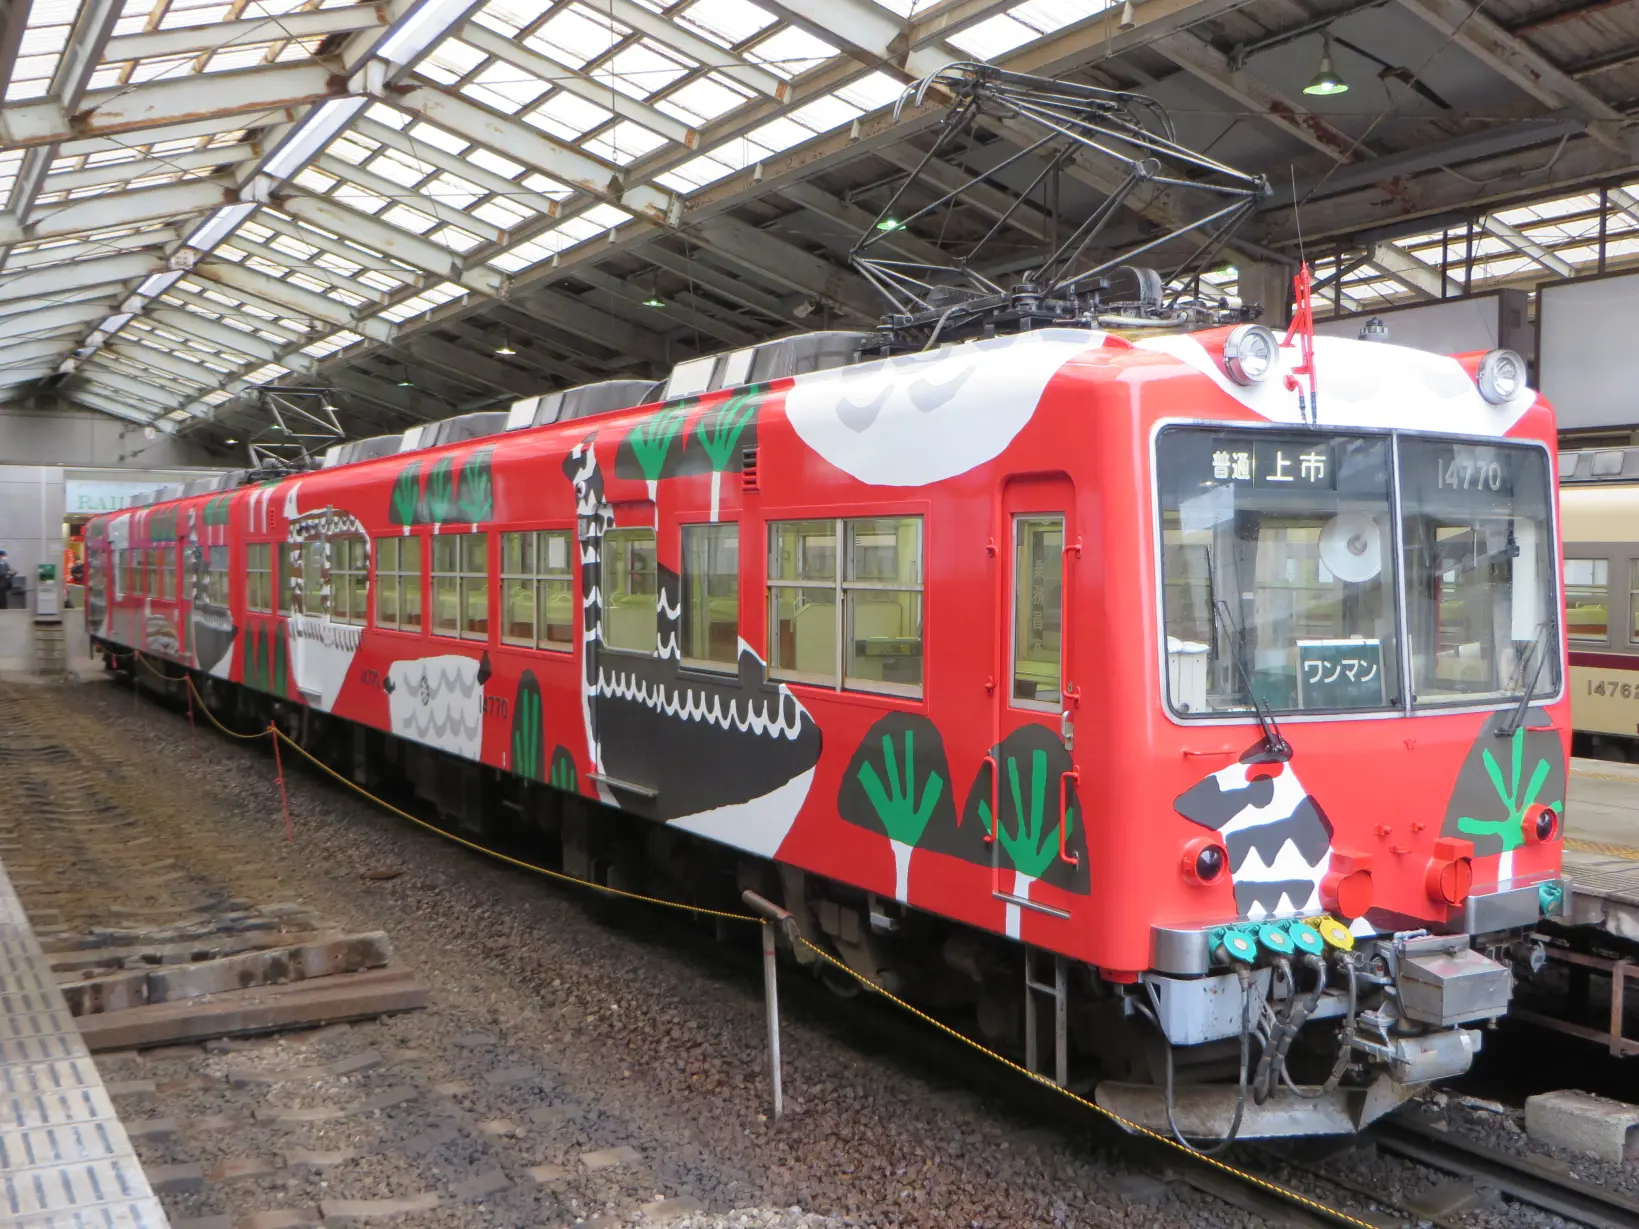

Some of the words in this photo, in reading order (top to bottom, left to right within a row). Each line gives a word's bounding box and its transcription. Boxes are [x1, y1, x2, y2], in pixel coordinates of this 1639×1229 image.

[1212, 450, 1250, 480] 普通
[1265, 451, 1326, 482] 上市
[1438, 458, 1501, 491] 14770
[1304, 659, 1377, 684] ワンマン
[479, 694, 508, 719] 14770
